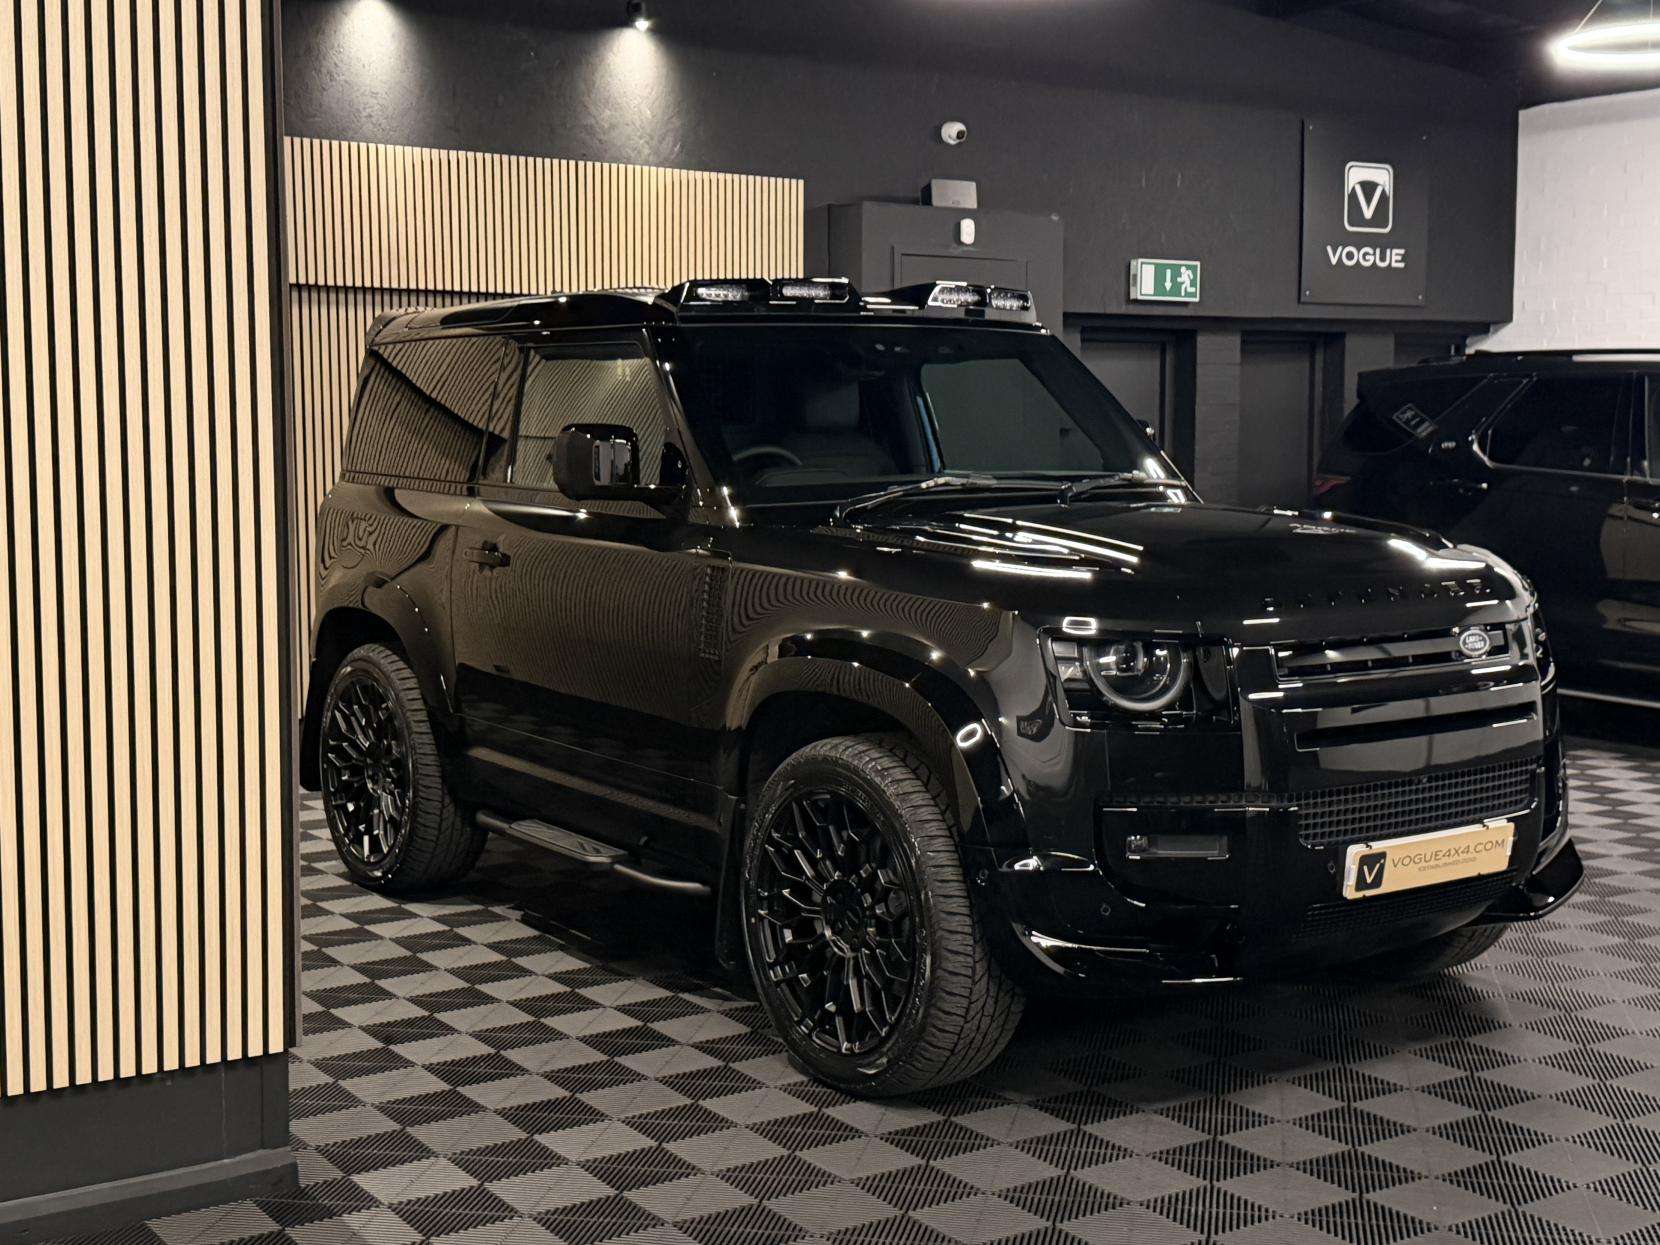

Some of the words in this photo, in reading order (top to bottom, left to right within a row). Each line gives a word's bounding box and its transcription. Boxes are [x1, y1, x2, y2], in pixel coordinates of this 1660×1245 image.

[1354, 183, 1384, 220] V
[1326, 244, 1406, 268] VOGUE
[1391, 838, 1506, 868] VOGUE4X4.COM
[1363, 858, 1385, 884] V
